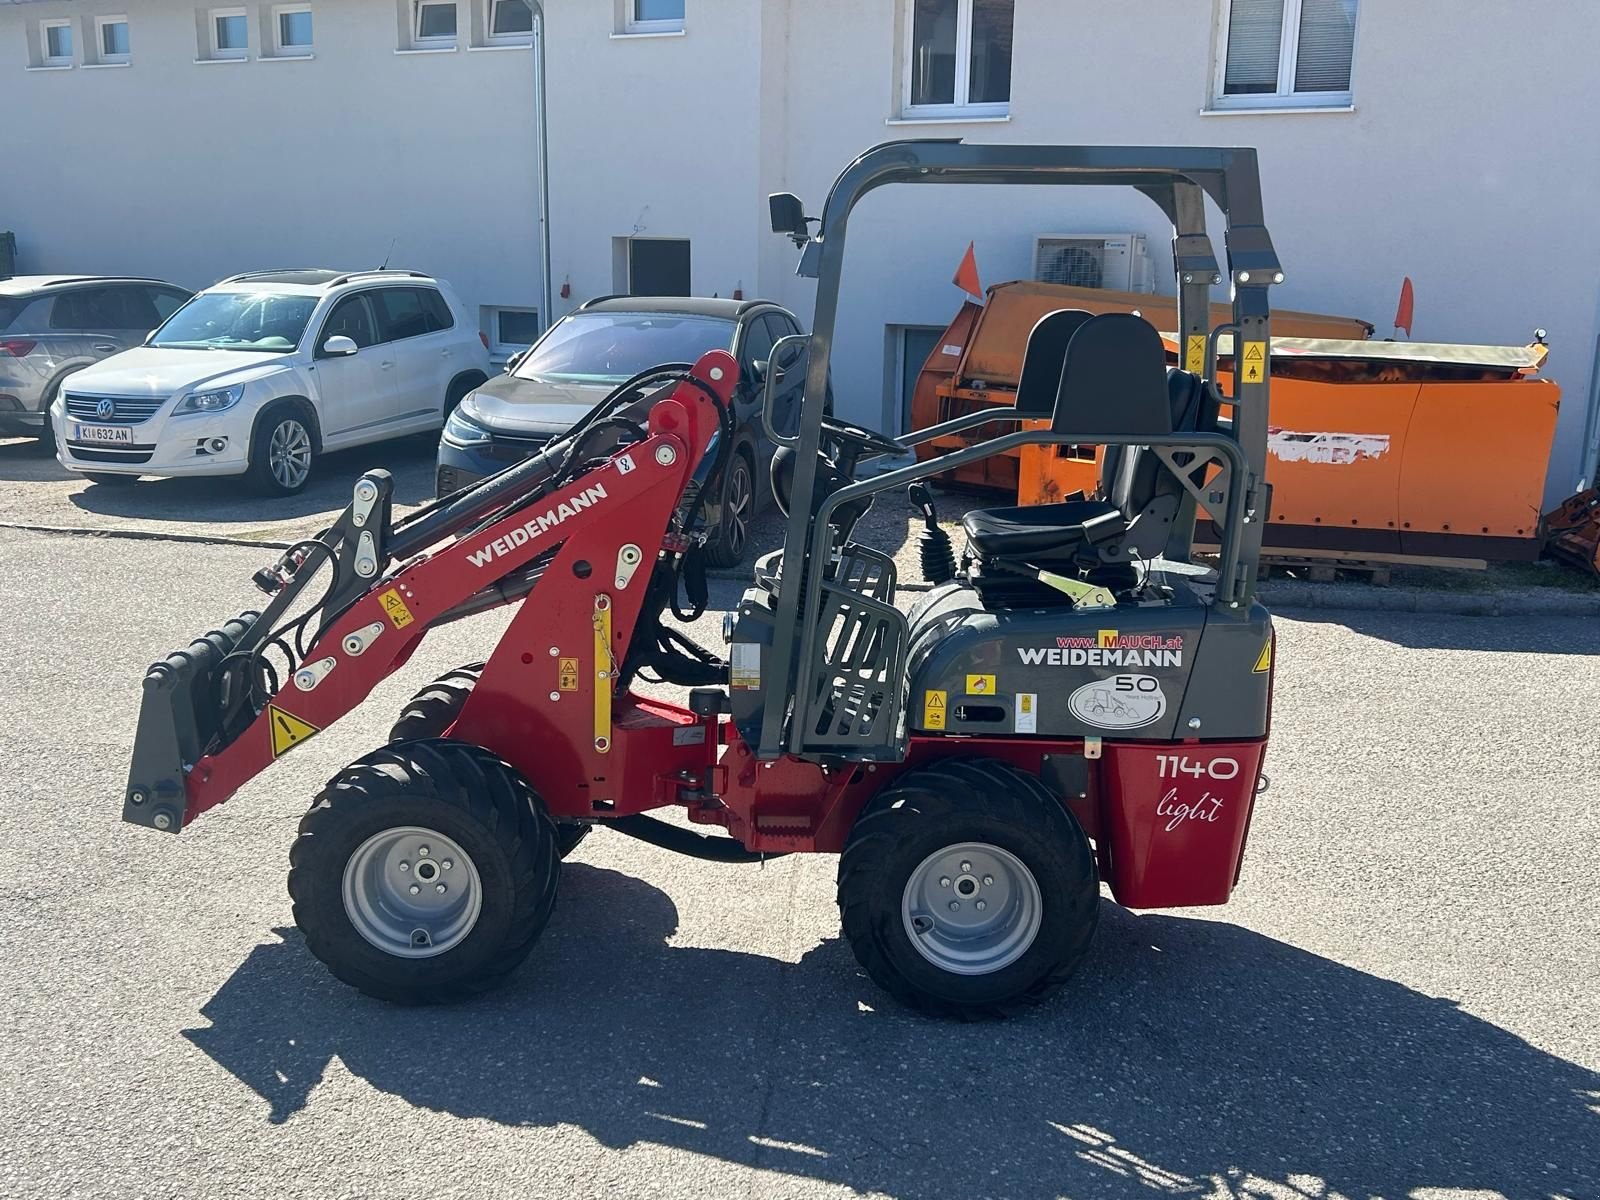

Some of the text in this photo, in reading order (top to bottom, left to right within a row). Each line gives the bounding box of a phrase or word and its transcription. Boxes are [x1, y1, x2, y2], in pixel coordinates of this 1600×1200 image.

[96, 428, 114, 440] 632
[115, 430, 128, 441] AN
[465, 482, 608, 568] WEIDEMANN
[1017, 647, 1182, 667] WEIDEMANN
[1115, 676, 1158, 693] 50
[1156, 755, 1239, 780] 1140
[1156, 787, 1224, 832] light
